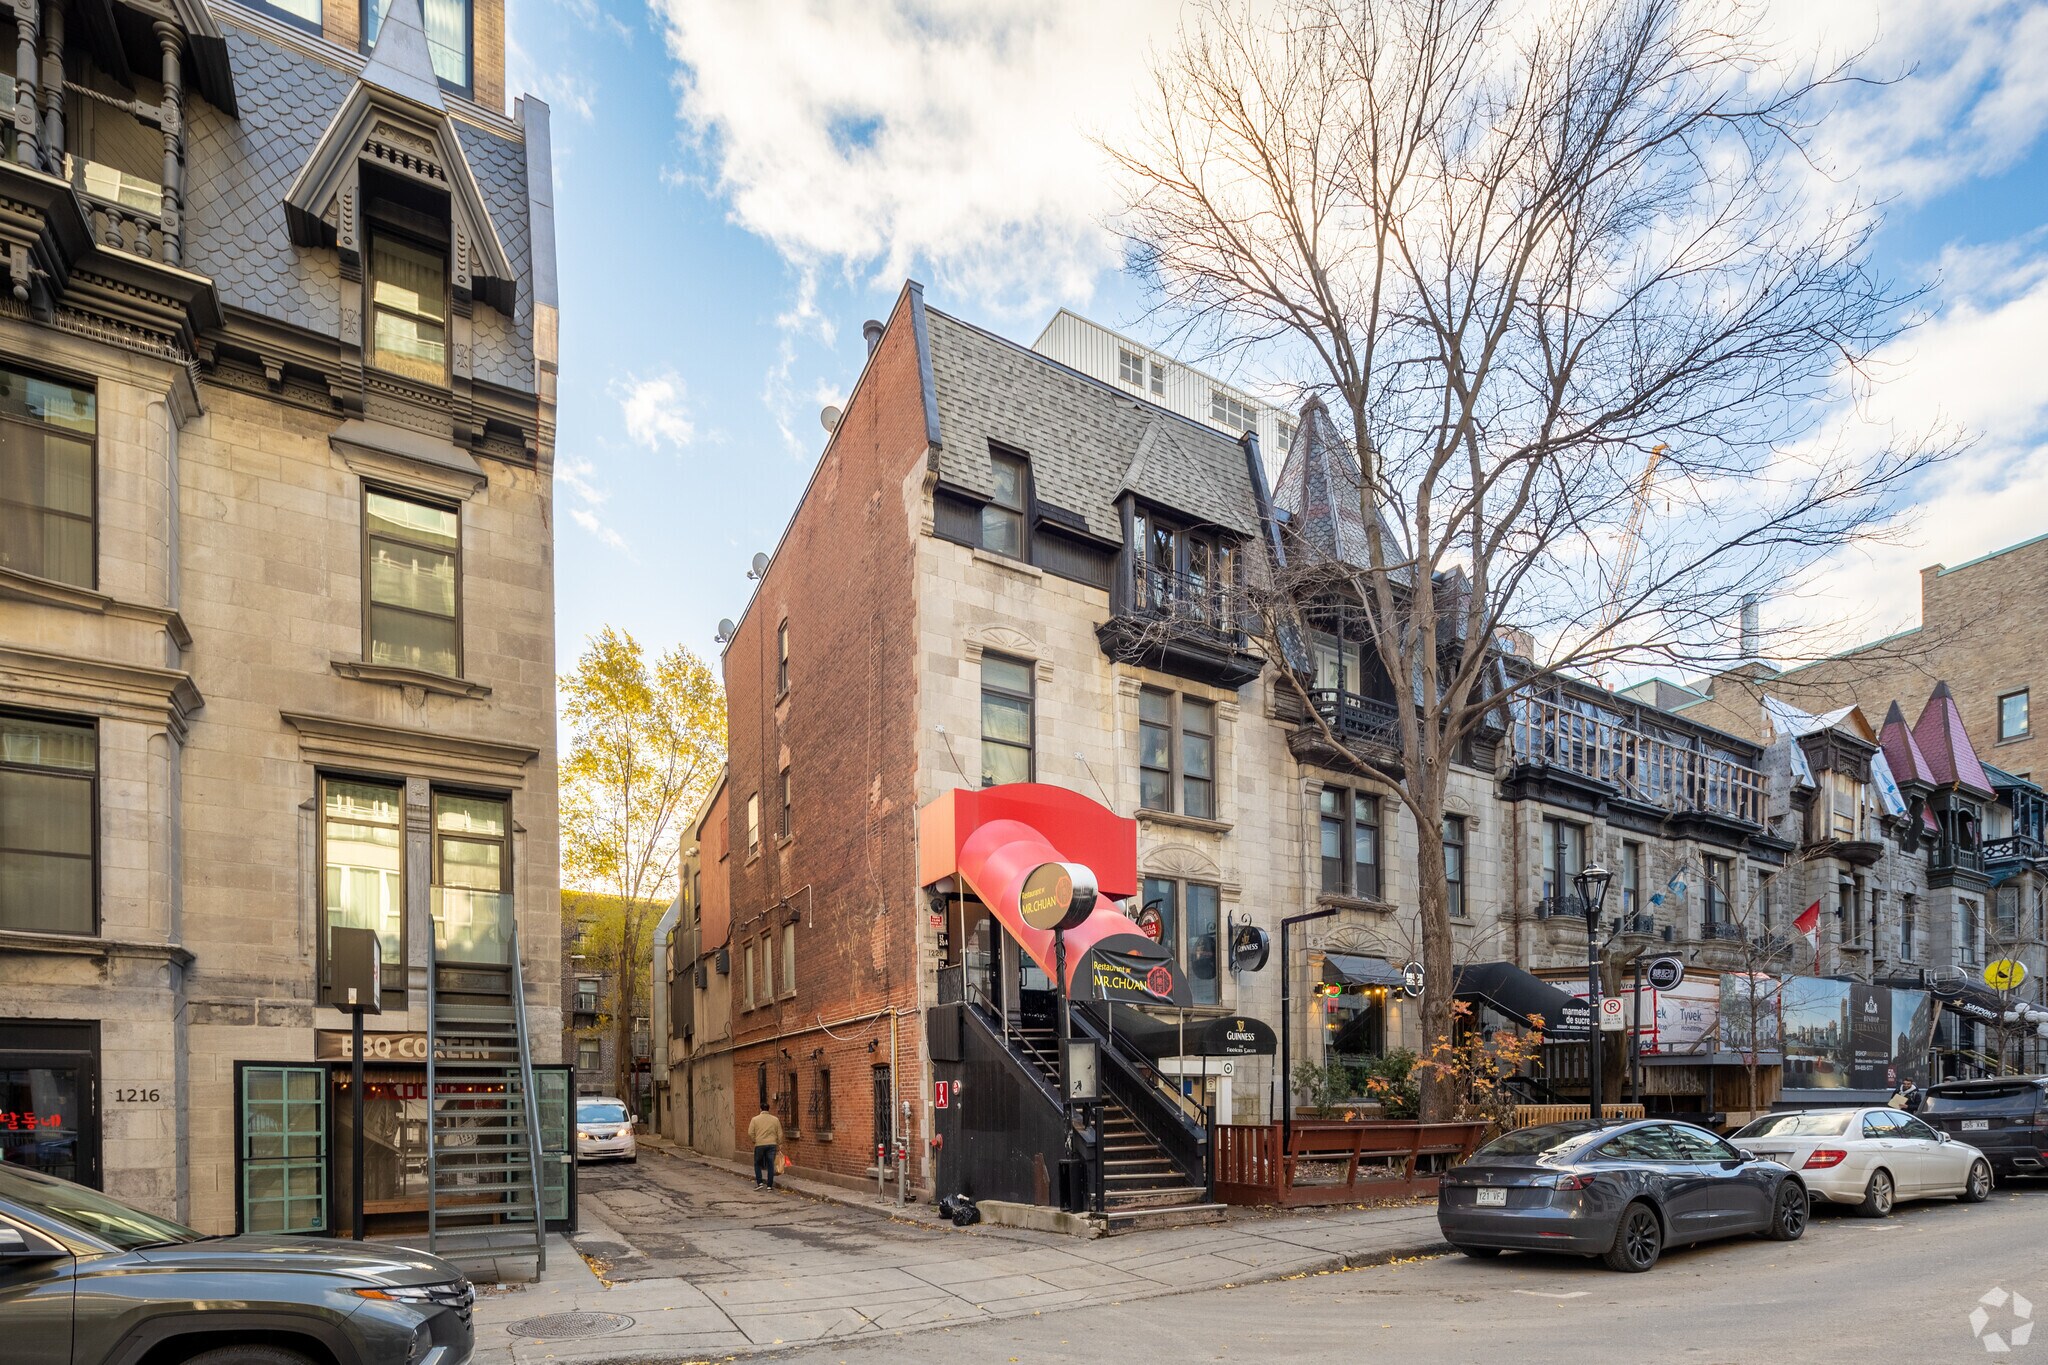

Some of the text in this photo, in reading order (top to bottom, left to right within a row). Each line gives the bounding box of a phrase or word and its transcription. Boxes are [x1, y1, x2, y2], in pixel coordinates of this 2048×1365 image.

[1237, 943, 1259, 952] GUINNESS
[1093, 961, 1125, 973] Restaurant
[1094, 975, 1147, 990] MR.CHUAN
[1566, 1016, 1590, 1025] de sucre
[1680, 1008, 1702, 1021] Tyvek
[1226, 1030, 1256, 1041] GUINNESS
[342, 1036, 392, 1059] BBQ
[115, 1088, 160, 1103] 1216
